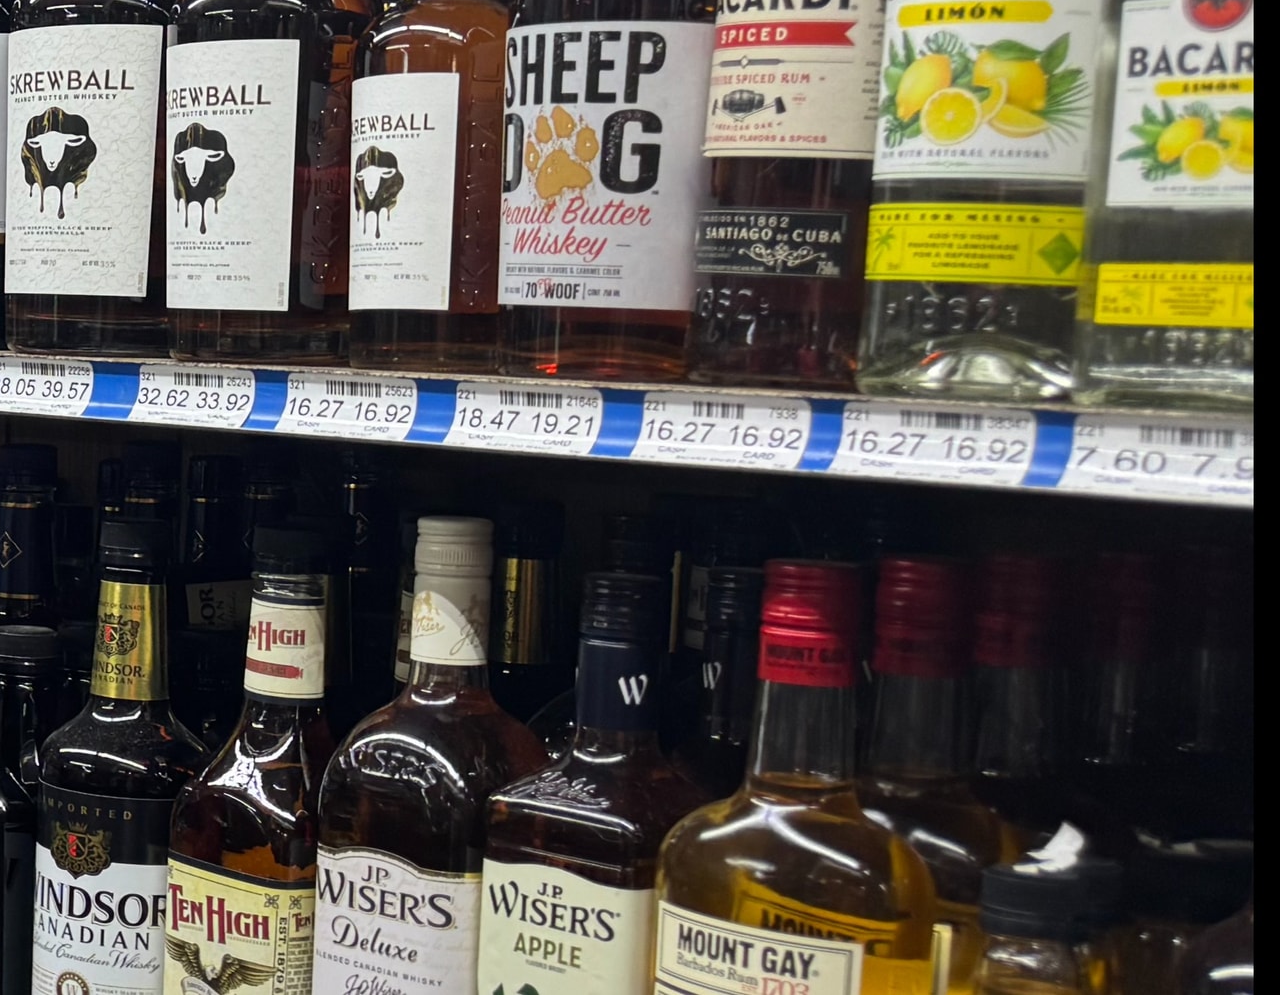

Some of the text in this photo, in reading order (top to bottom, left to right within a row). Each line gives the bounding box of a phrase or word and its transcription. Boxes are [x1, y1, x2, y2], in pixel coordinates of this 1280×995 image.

[923, 3, 1007, 22] LIMÓN
[720, 25, 789, 45] SPICED
[10, 68, 135, 96] SKREWBALL
[504, 31, 667, 105] SHEEP
[38, 94, 69, 102] BUTTER
[73, 92, 118, 101] WHISKEY
[502, 196, 652, 227] Peanut Butter
[749, 215, 790, 228] 1862
[513, 226, 608, 263] Whiskey
[705, 226, 770, 241] SANTIAGO
[792, 229, 841, 243] CUBA
[41, 379, 90, 401] 39.57
[138, 387, 251, 413] 32.62 33.92
[384, 385, 414, 398] 25623
[287, 396, 411, 426] 16.27 16.92
[457, 406, 594, 437] 18.47 19.21
[645, 418, 804, 450] 16.27 16.92
[1075, 445, 1167, 475] 7.60
[257, 620, 306, 652] HIGH
[618, 674, 648, 706] W
[317, 867, 454, 929] WISER'S
[488, 880, 616, 942] WISER'S
[168, 883, 270, 945] TEN HIGH
[331, 915, 418, 964] Deluxe
[513, 932, 582, 969] APPLE
[677, 922, 815, 981] MOUNT GAY
[676, 953, 759, 989] Barbados Rum
